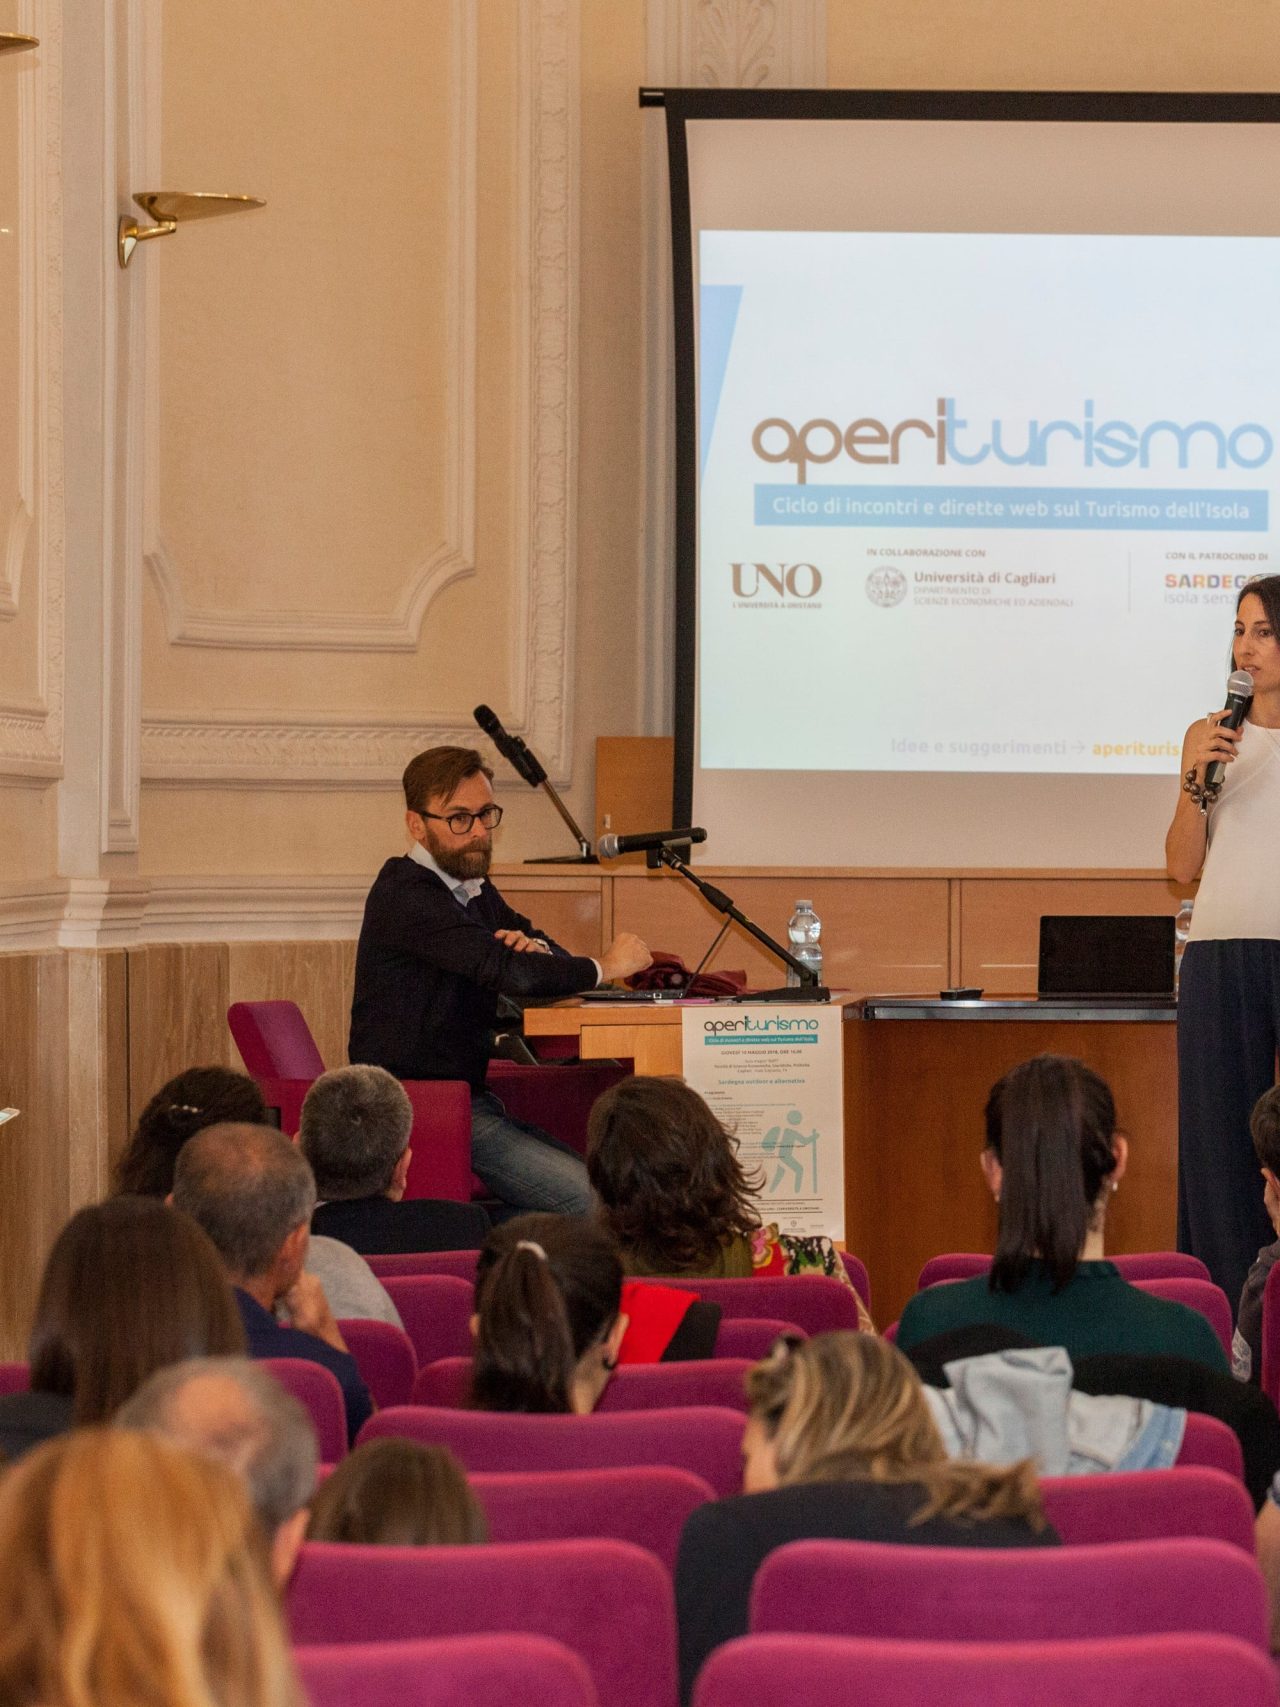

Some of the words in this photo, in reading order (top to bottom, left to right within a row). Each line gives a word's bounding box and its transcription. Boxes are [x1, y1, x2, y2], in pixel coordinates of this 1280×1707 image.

[751, 398, 1273, 485] aperiturismo
[773, 497, 818, 514] Ciclo
[823, 497, 843, 515] di
[846, 497, 919, 516] incontri
[923, 502, 934, 516] e
[939, 498, 1004, 517] dirette
[1010, 500, 1048, 517] web
[1054, 500, 1080, 518] sul
[1085, 501, 1160, 519] Turismo
[1166, 501, 1250, 520] dell'Isola
[866, 548, 878, 557] IN
[879, 548, 963, 558] COLLABORAZIONE
[965, 549, 986, 558] CON
[1165, 552, 1186, 560] CON
[1188, 552, 1197, 560] IL
[1199, 552, 1256, 561] PATROCINIO
[1258, 553, 1269, 561] DI
[730, 563, 823, 598] UNO
[914, 571, 985, 584] Università
[988, 571, 1001, 584] di
[1004, 572, 1056, 587] Cagliari
[1165, 574, 1256, 588] SARDEG
[1164, 591, 1198, 605] isola
[891, 738, 929, 754] Idee
[934, 742, 944, 754] e
[949, 738, 1067, 758] suggerimenti
[1092, 741, 1180, 758] aperituris
[704, 1015, 819, 1037] aperiturismo
